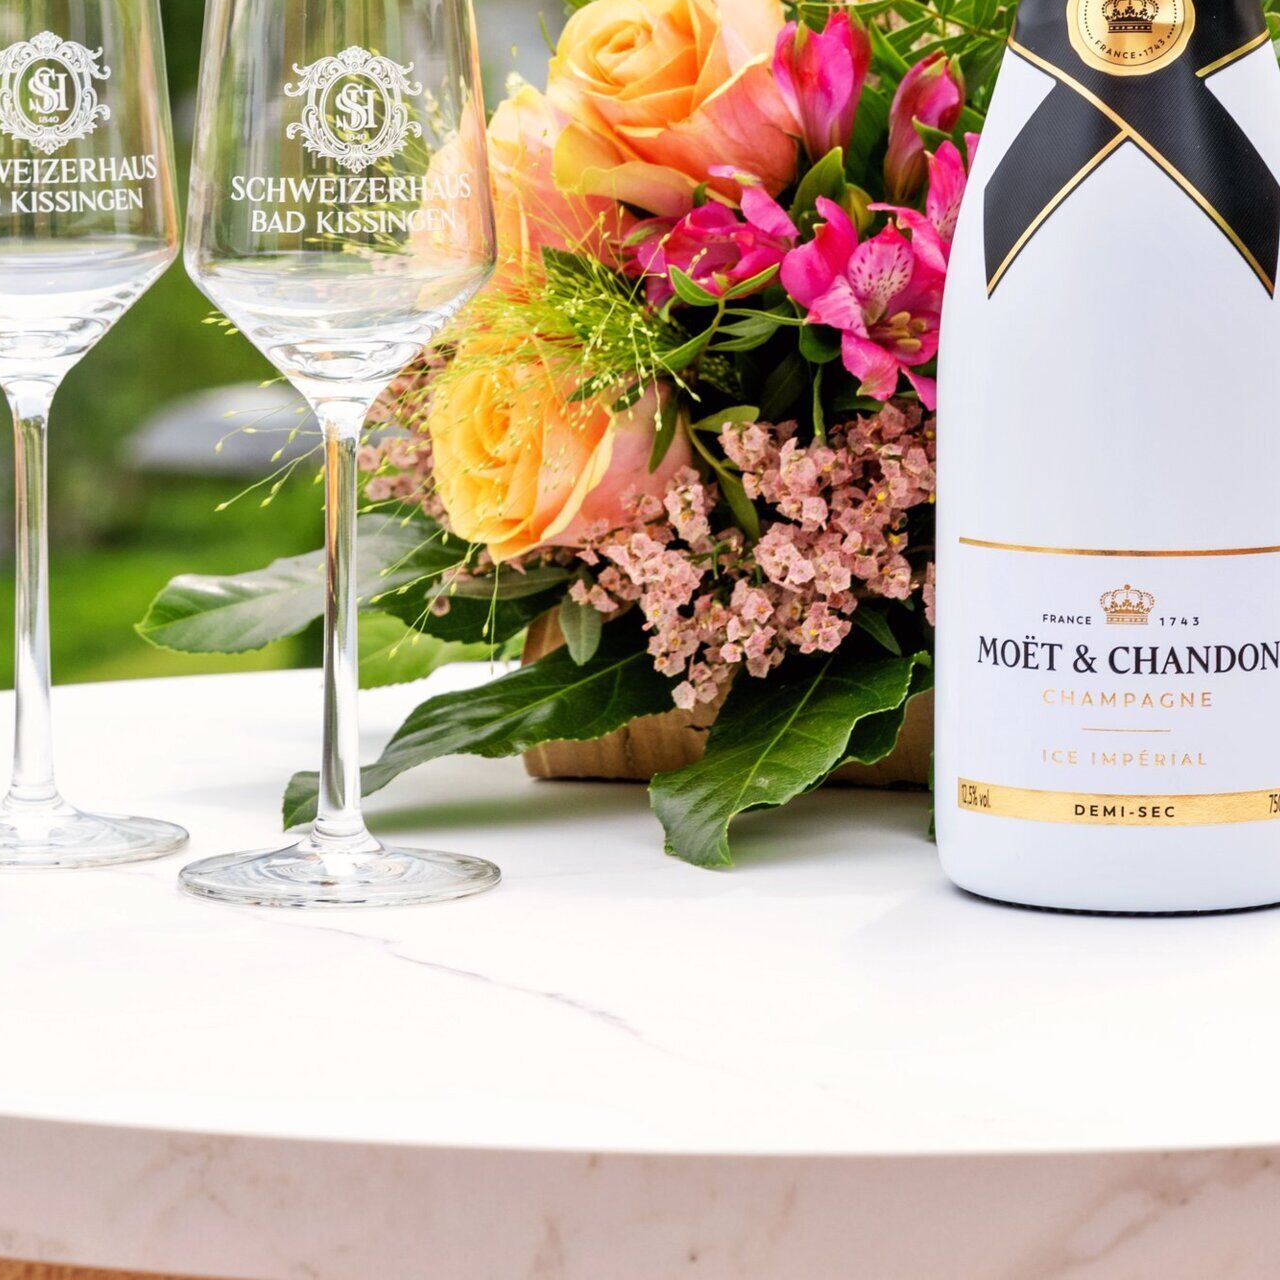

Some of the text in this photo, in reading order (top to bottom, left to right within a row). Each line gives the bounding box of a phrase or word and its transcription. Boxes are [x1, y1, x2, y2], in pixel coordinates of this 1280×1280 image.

[1094, 38, 1166, 59] FRANCE 1743
[230, 173, 472, 204] SCHWEIZERHAUS
[11, 187, 144, 214] KISSINGEN
[251, 208, 458, 235] BAD KISSINGEN
[1042, 614, 1200, 626] FRANCE 1743
[977, 635, 1280, 675] MOËT & CHANDON
[1042, 688, 1213, 708] CHAMPAGNE
[1042, 749, 1208, 767] ICE IMPÉRIAL
[1074, 804, 1176, 818] DEMI-SEC
